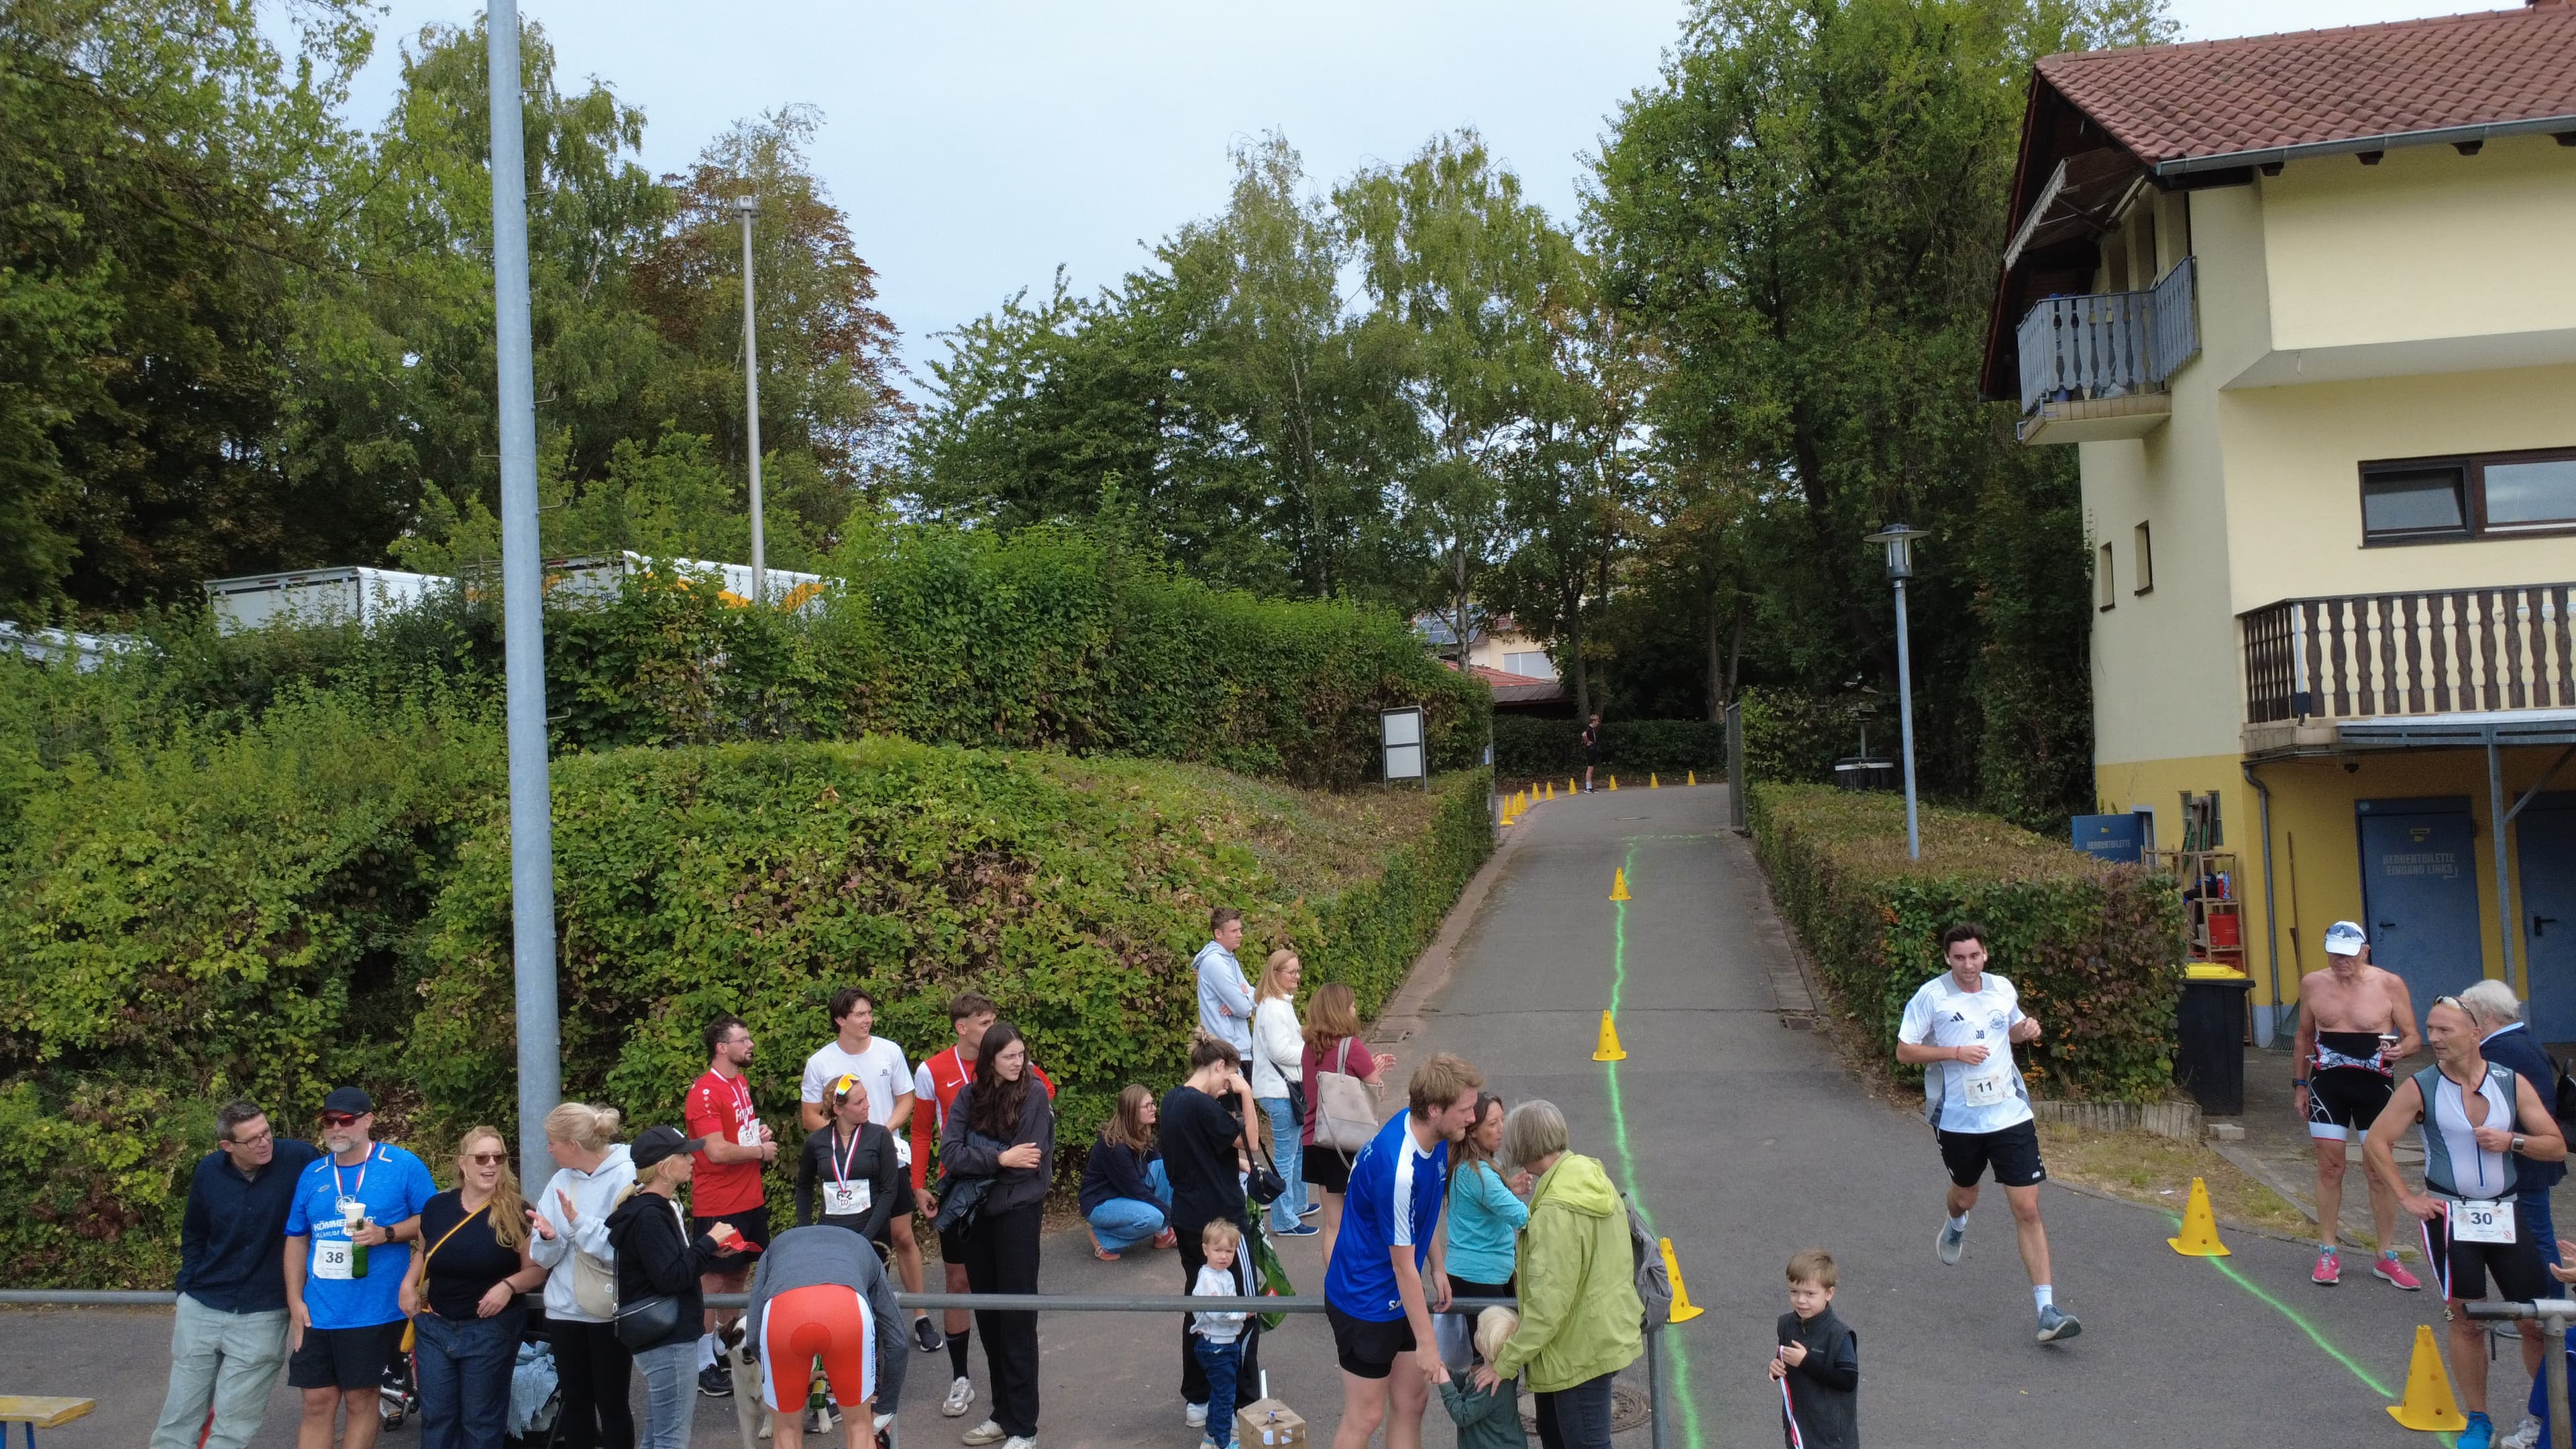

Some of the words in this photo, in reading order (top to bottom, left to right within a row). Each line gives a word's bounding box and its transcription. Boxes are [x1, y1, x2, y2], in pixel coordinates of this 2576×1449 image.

[1977, 1081, 1992, 1093] 11
[837, 1190, 853, 1200] 62
[2470, 1212, 2493, 1225] 30
[325, 1251, 344, 1264] 38
